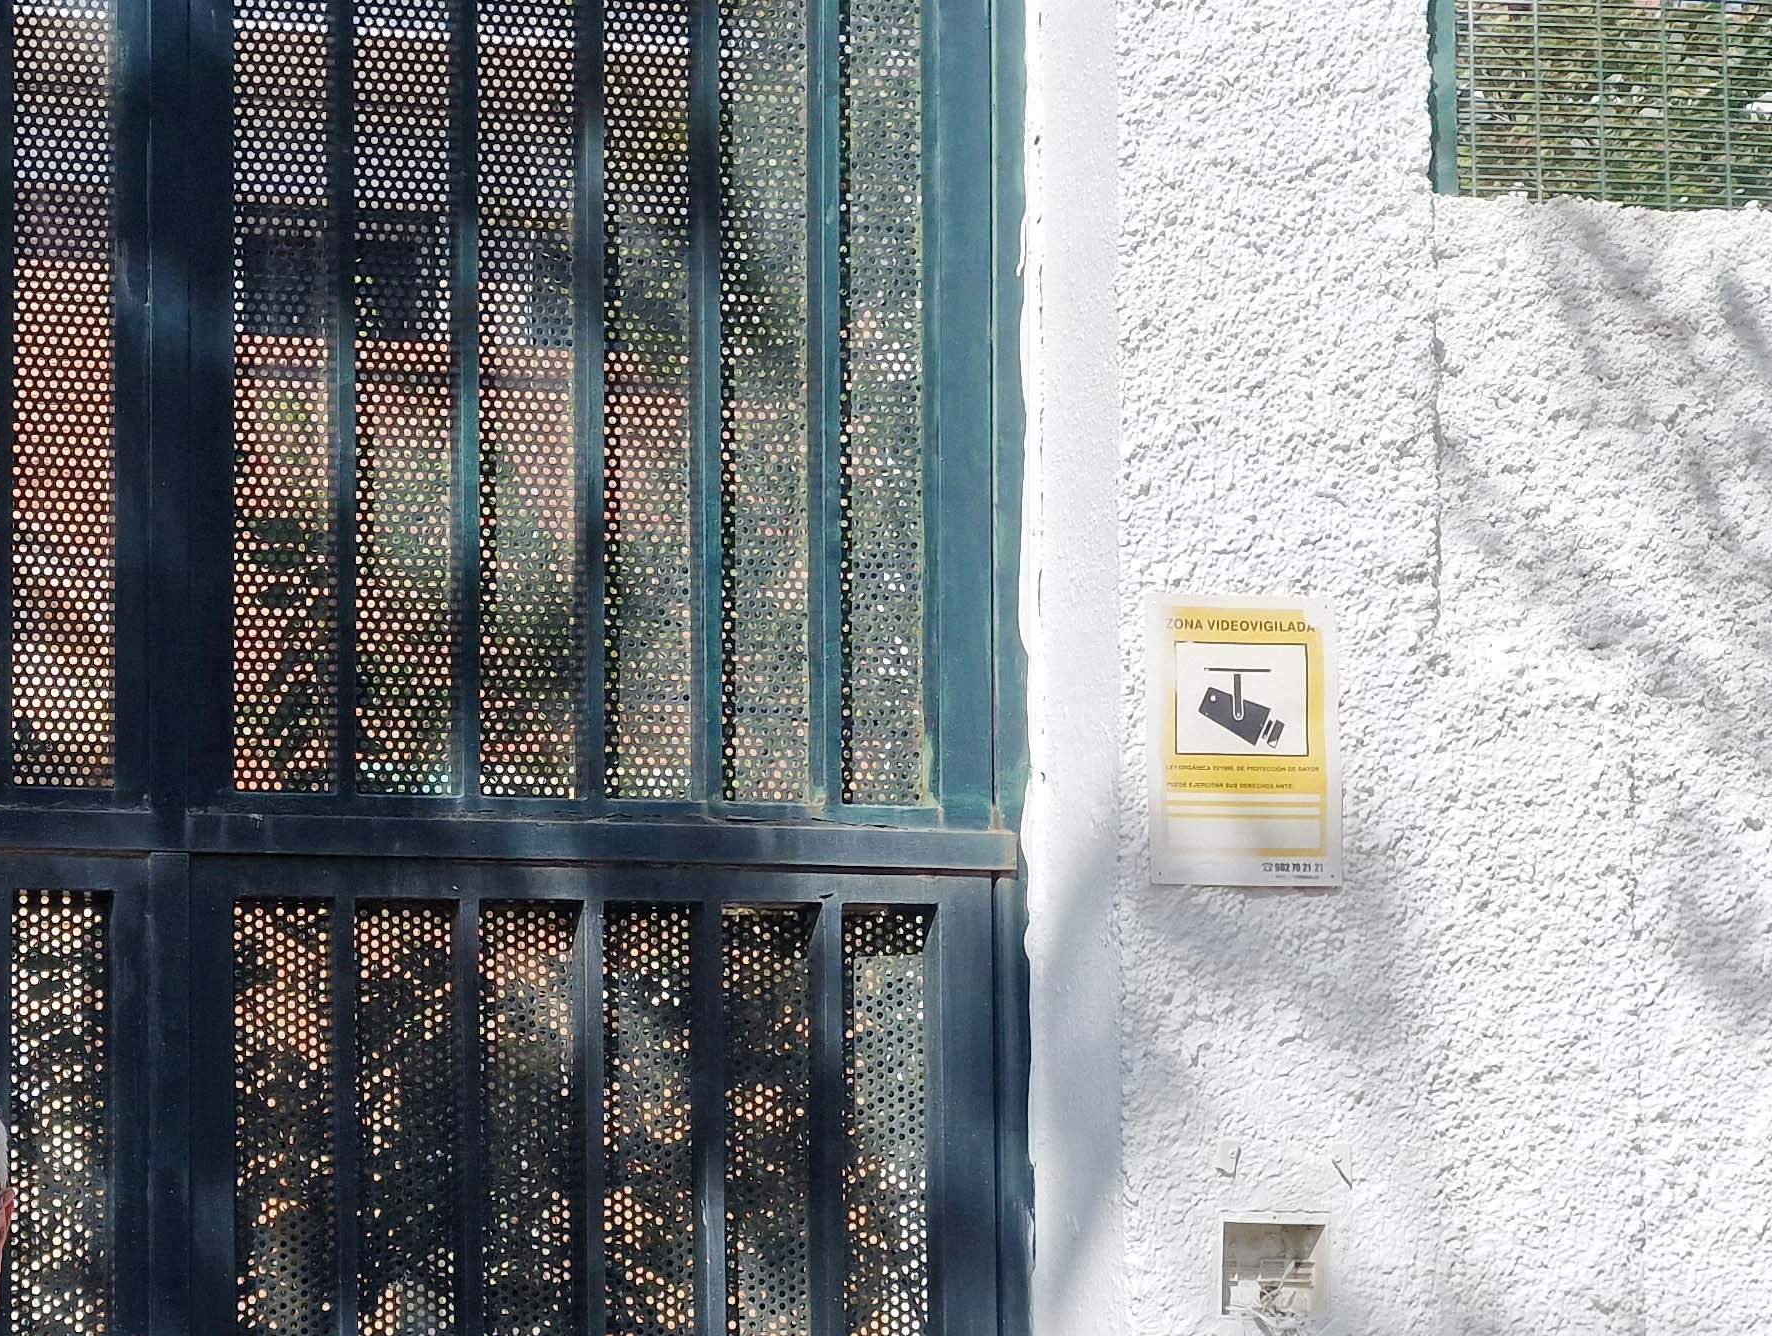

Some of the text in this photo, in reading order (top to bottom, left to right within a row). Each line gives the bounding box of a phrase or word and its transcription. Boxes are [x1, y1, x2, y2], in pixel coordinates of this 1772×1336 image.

[1165, 618, 1203, 630] ZONA
[1274, 863, 1290, 872] 902
[1302, 863, 1311, 872] 21
